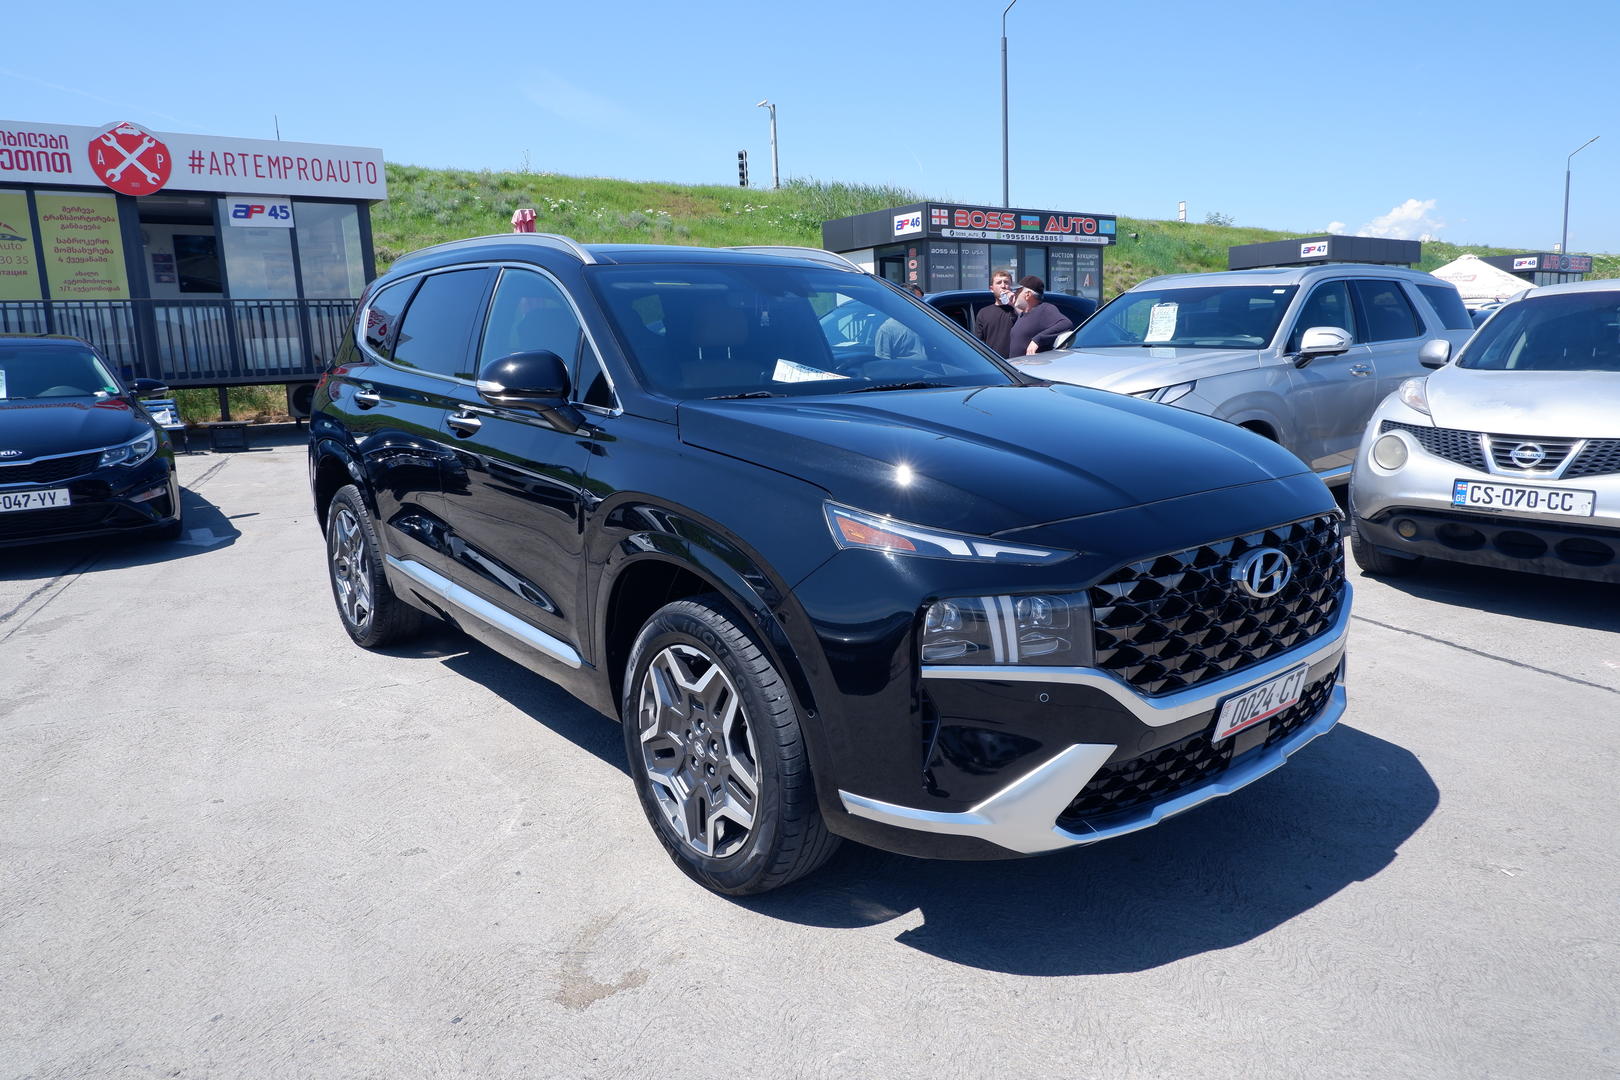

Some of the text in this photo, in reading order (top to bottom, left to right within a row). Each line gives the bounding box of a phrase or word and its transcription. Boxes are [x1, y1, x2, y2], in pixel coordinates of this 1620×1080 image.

[97, 149, 105, 165] A
[156, 153, 164, 169] P
[188, 150, 377, 185] #ARTEMPROAUTO
[268, 204, 290, 220] 45
[910, 216, 920, 228] 46
[954, 209, 1096, 235] BOSS AUTO
[1317, 244, 1326, 253] 47
[0, 270, 28, 278] тация
[1470, 485, 1574, 511] CS-070-CC
[1229, 683, 1276, 729] 0024
